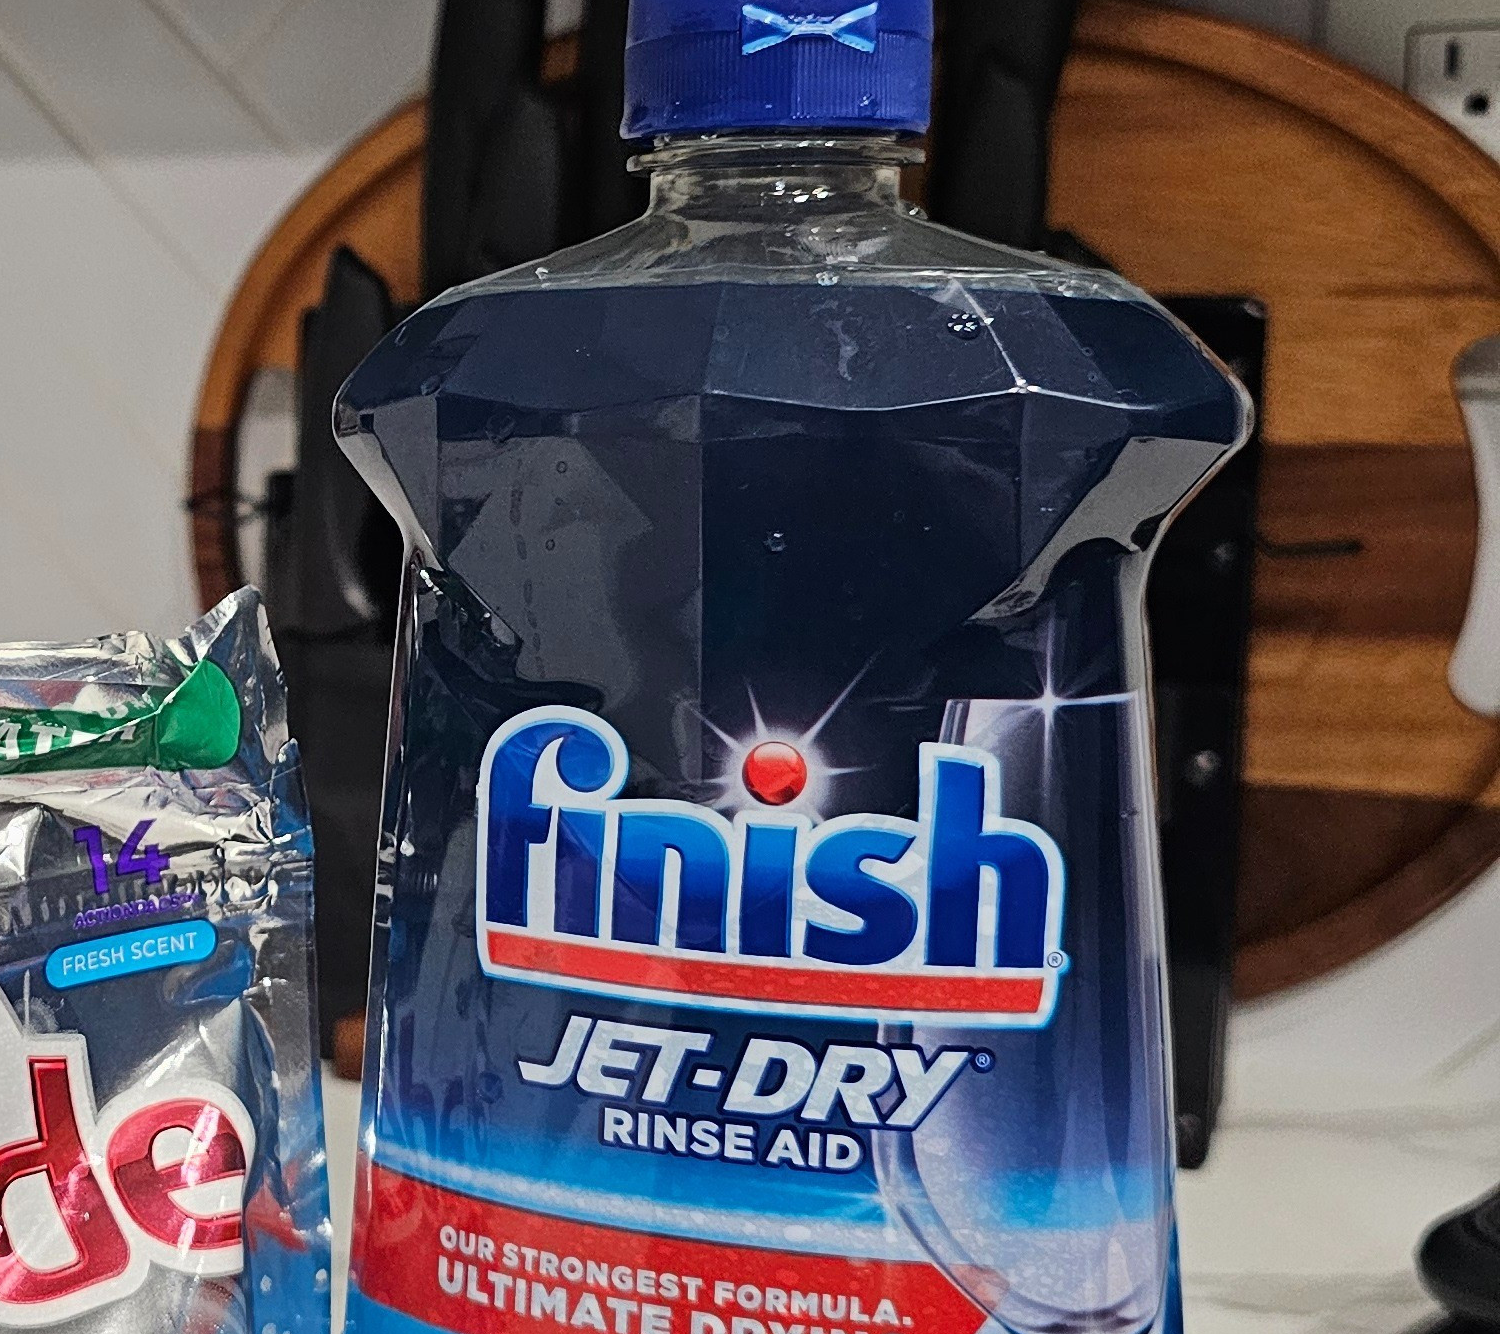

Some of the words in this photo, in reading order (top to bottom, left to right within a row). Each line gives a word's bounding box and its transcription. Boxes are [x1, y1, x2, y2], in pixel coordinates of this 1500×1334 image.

[72, 817, 171, 896] 14
[62, 945, 125, 976] FRESH
[130, 931, 198, 960] SCENT
[602, 1107, 754, 1161] RINSE
[768, 1128, 862, 1171] AID
[438, 1224, 495, 1263] OUR
[501, 1240, 704, 1303] STRONGEST
[713, 1278, 914, 1327] FORMULA.
